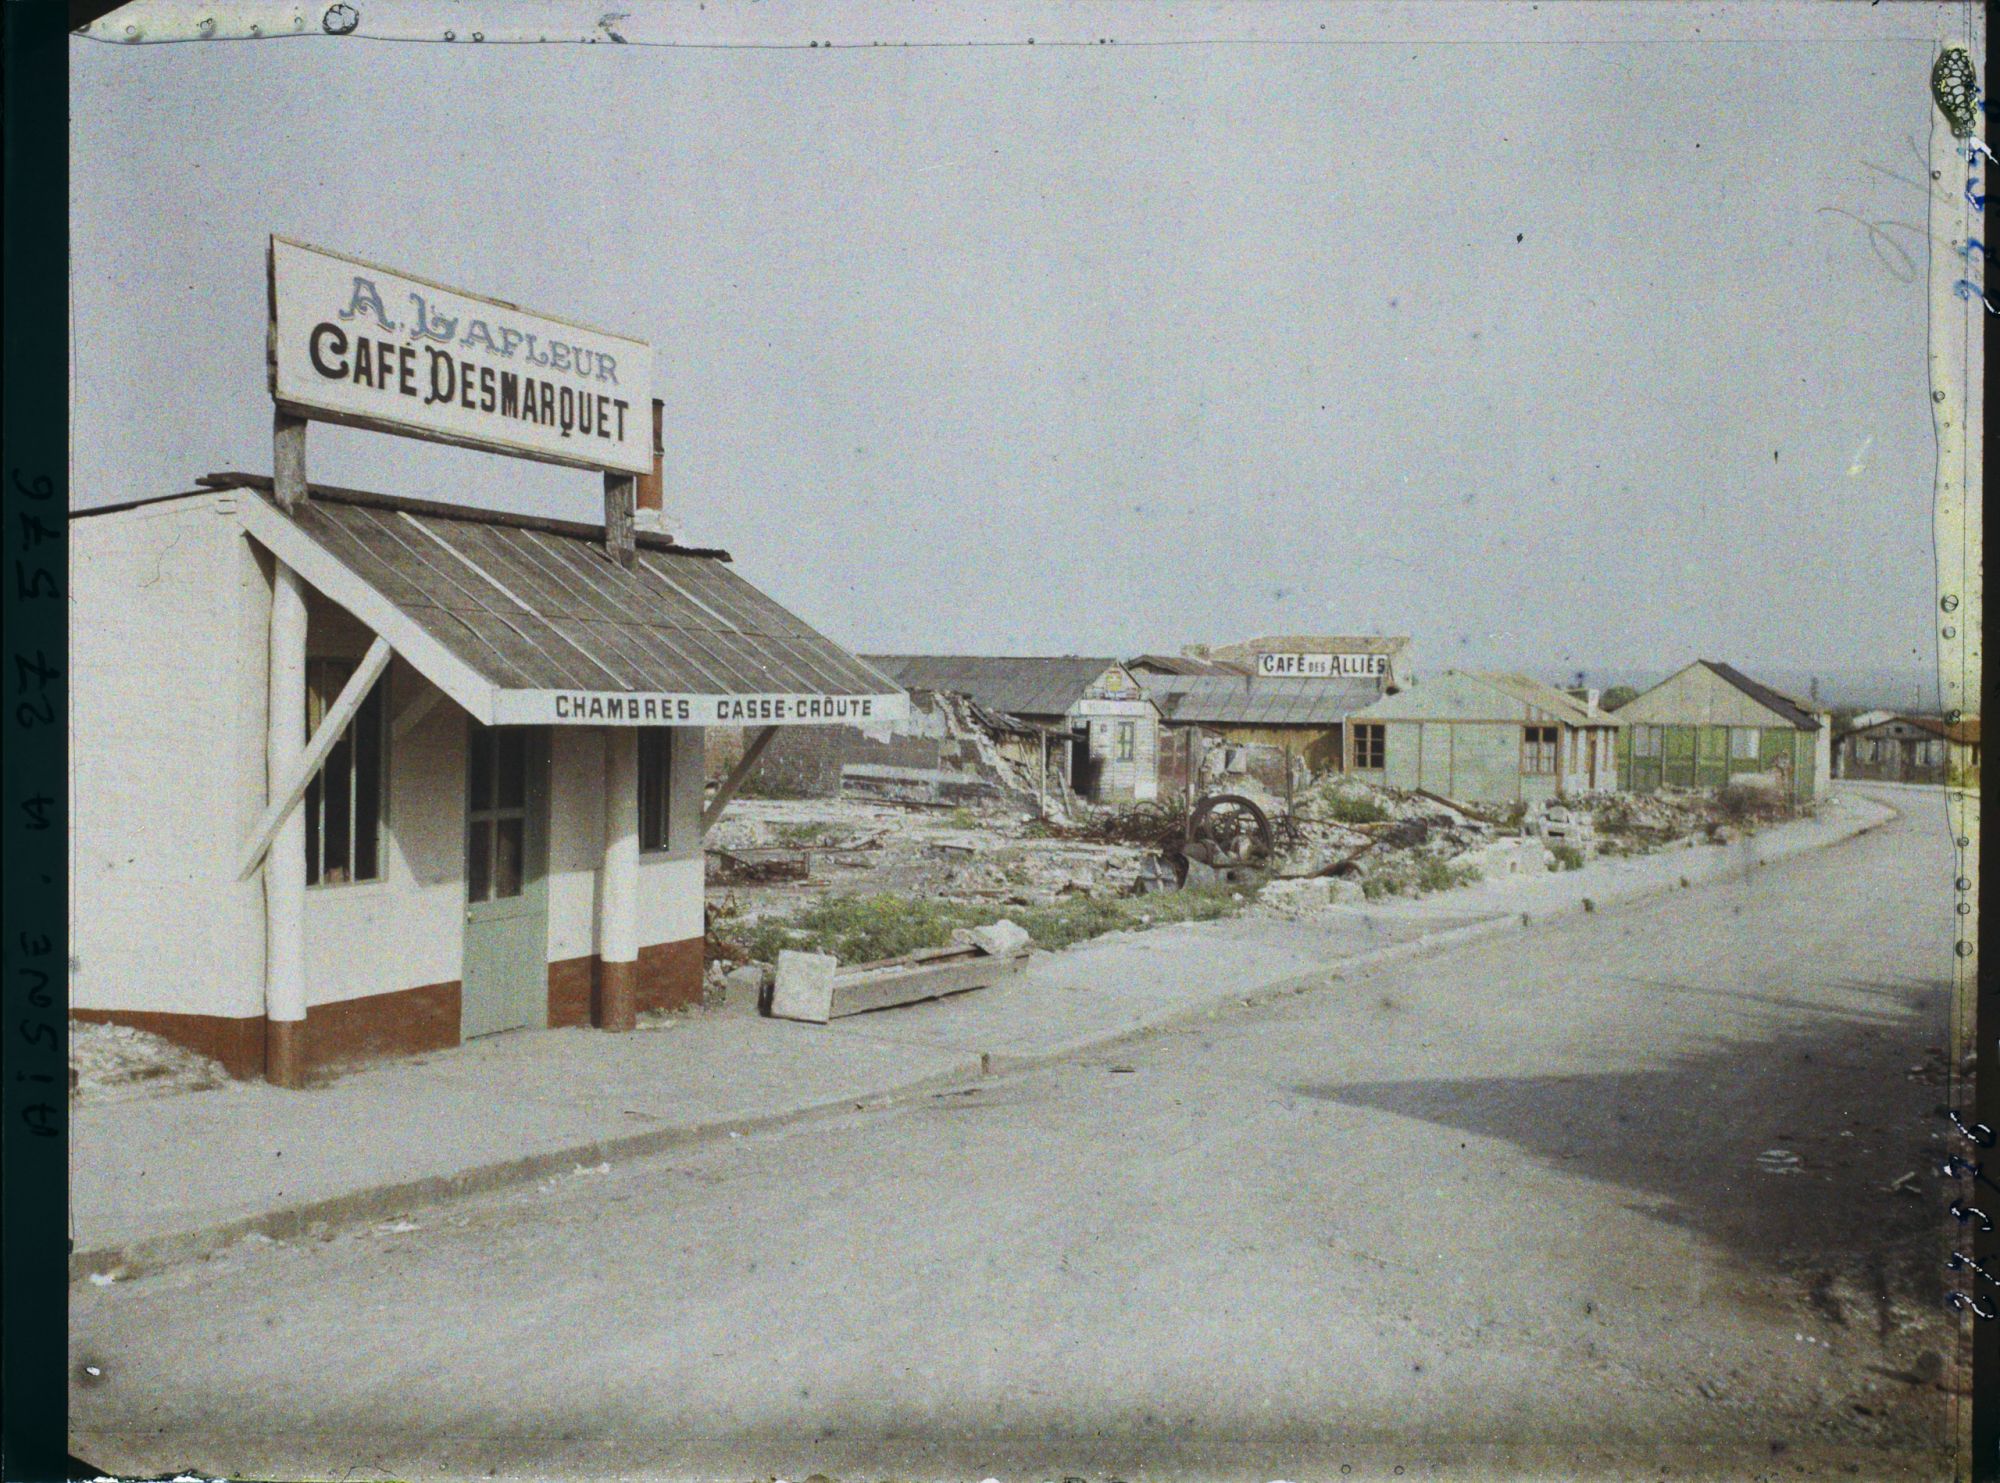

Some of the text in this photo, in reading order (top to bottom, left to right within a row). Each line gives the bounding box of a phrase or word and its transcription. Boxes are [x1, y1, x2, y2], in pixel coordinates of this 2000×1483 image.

[424, 345, 629, 442] DESMARQUET
[1263, 652, 1385, 675] CAFÉ DES ALLIÉS
[555, 695, 873, 720] CHAMBRES CASSE-CROÛTE
